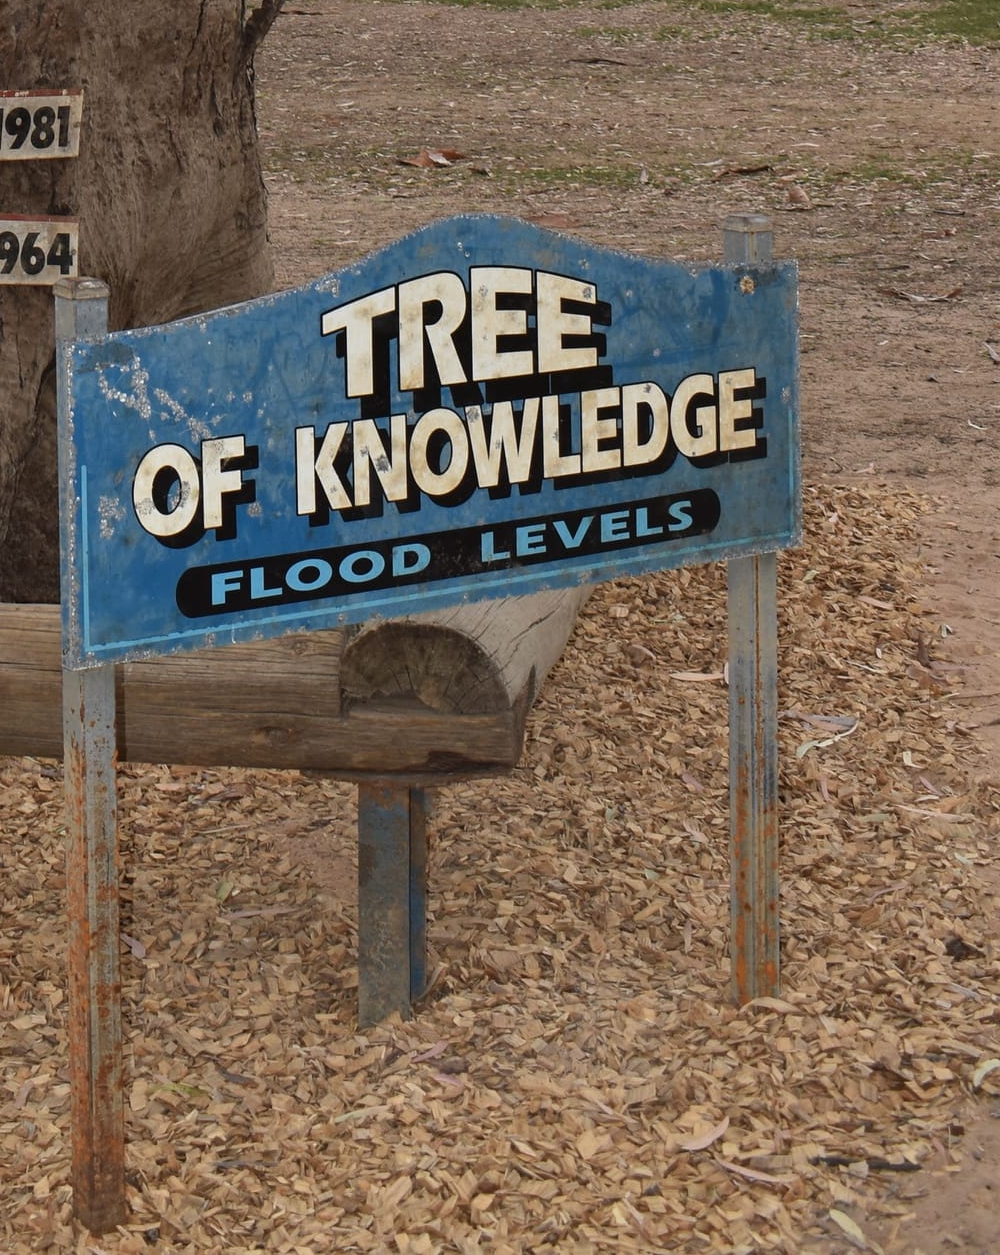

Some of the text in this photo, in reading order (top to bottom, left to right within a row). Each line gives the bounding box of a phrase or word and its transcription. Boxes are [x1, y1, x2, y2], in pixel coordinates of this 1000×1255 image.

[321, 266, 599, 398] TREE
[133, 368, 757, 537] OF KNOWLEDGE
[211, 499, 694, 606] FLOOD LEVELS
